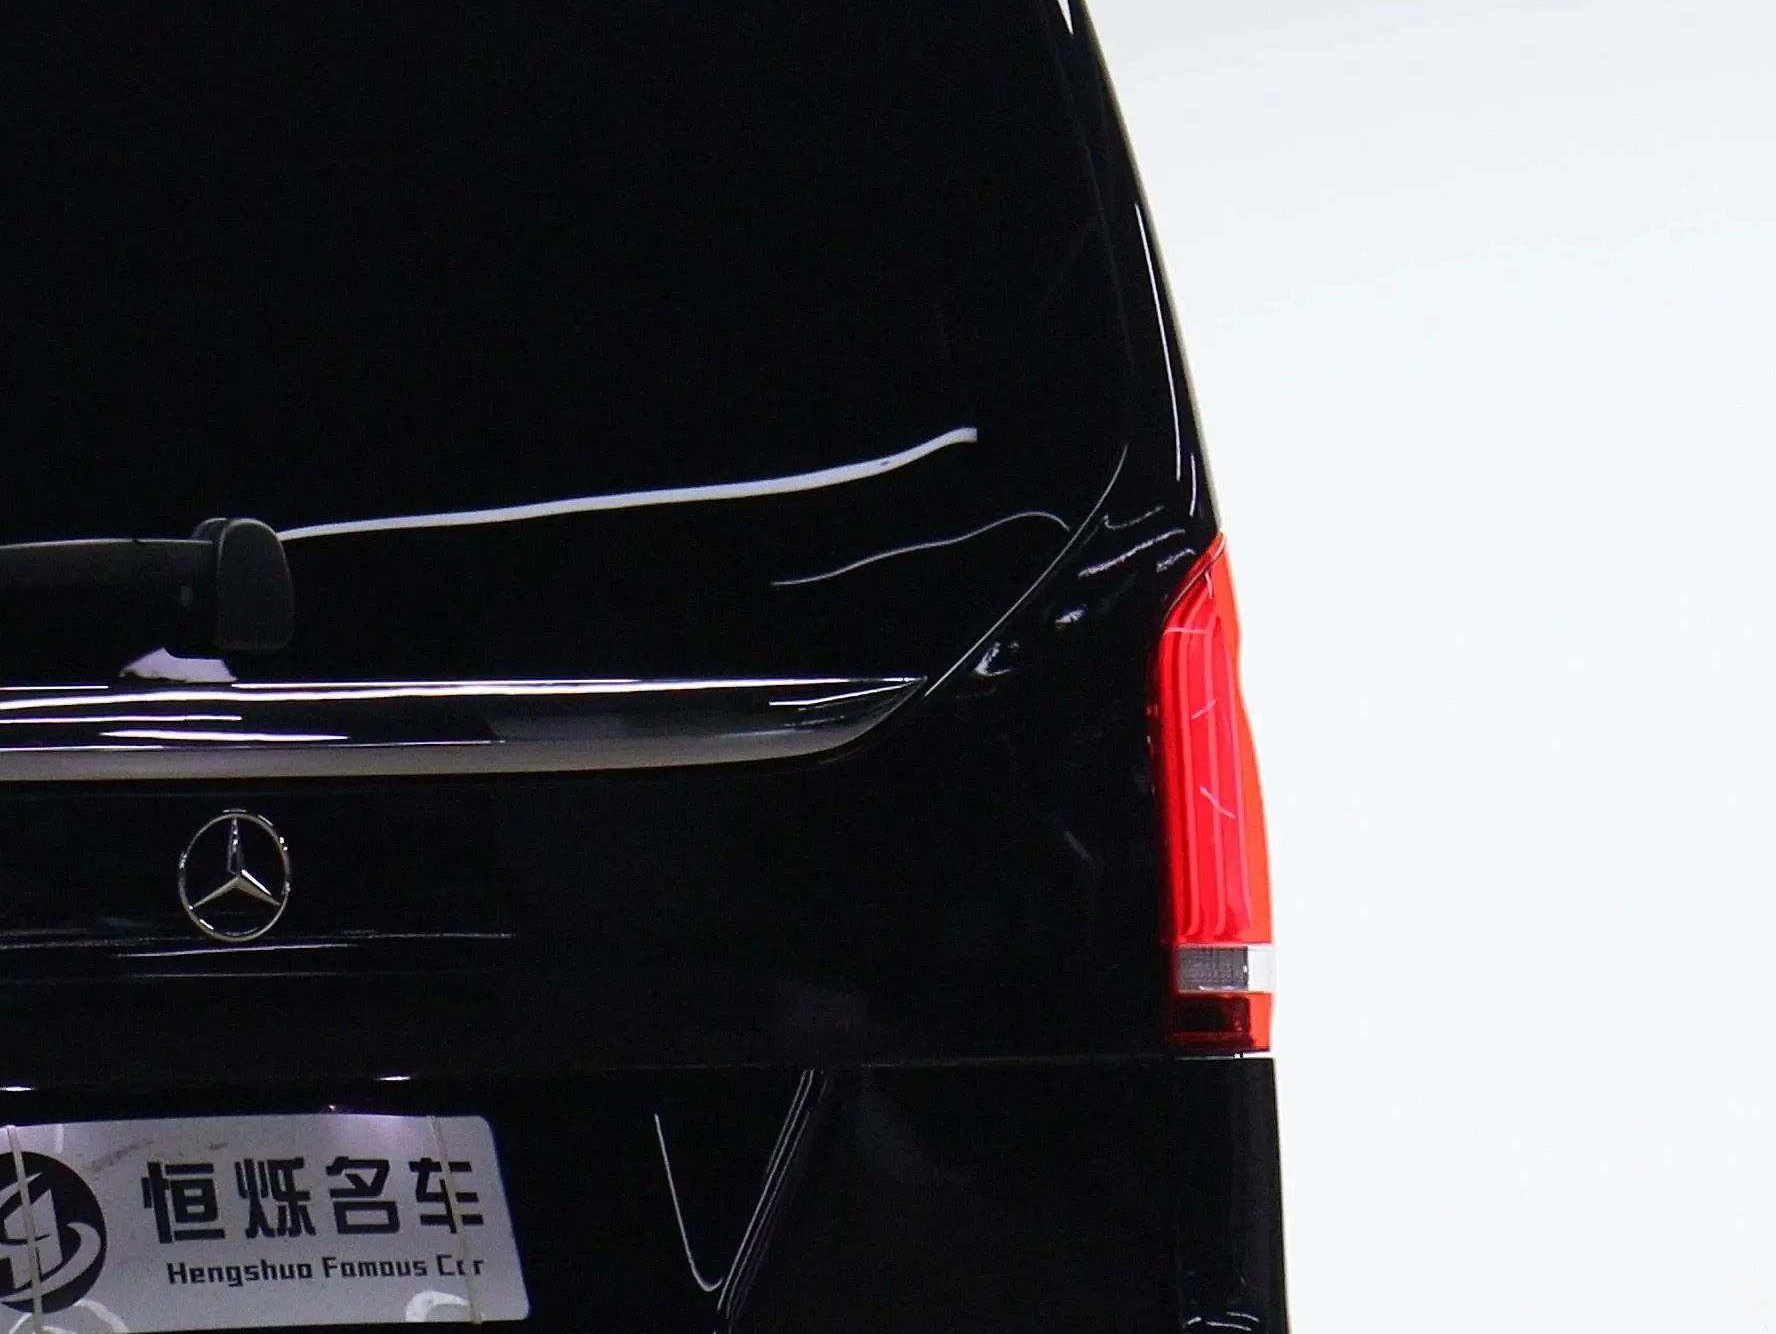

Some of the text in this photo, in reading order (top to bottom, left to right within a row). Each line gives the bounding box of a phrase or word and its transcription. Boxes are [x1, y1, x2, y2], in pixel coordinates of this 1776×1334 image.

[140, 1156, 484, 1244] 恒烁名车
[166, 1259, 313, 1288] Hengshuo
[321, 1256, 428, 1278] Famous
